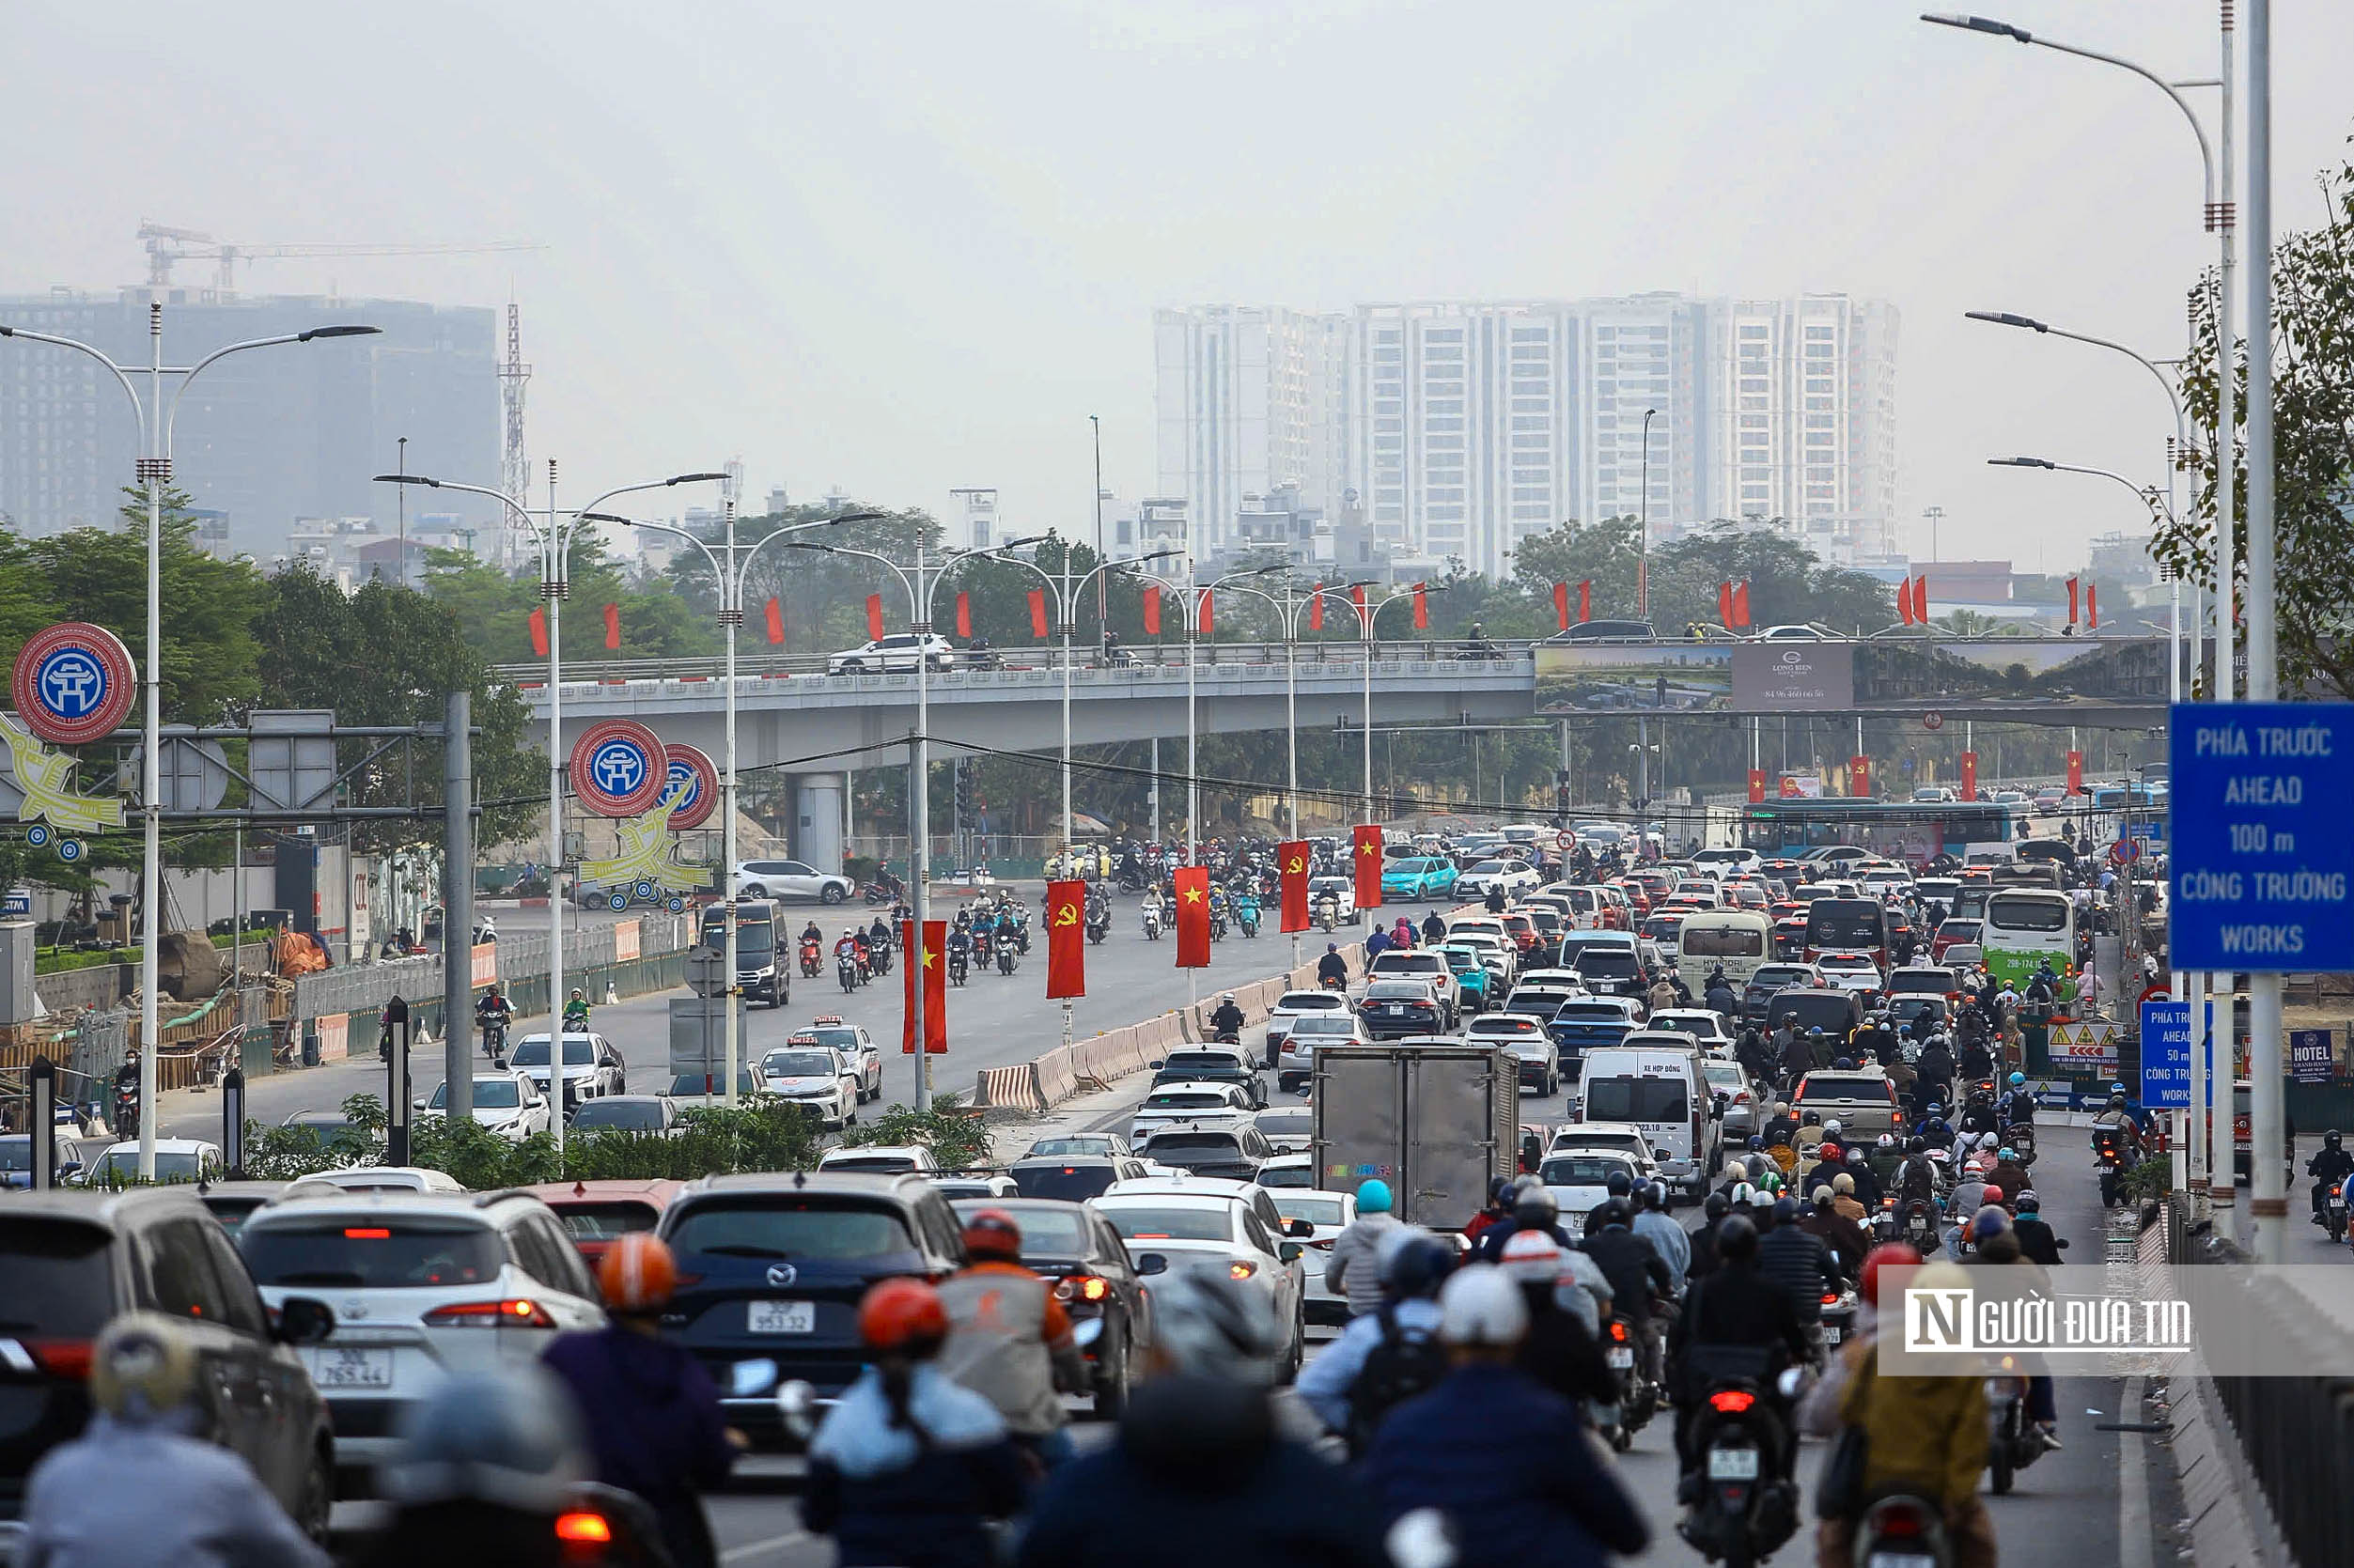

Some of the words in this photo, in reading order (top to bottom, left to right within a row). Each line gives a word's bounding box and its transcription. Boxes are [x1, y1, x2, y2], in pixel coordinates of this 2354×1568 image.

[2195, 719, 2249, 755] PHÍA
[2224, 775, 2302, 804] AHEAD
[2230, 823, 2268, 852] 100
[2274, 831, 2294, 852] m
[2180, 867, 2243, 900] CÔNG
[2220, 924, 2303, 953] WORKS
[2151, 1010, 2173, 1023] PHÍA
[2167, 1049, 2178, 1061] 50
[2180, 1052, 2189, 1061] m
[2294, 1046, 2330, 1062] HOTEL
[1652, 1064, 1663, 1073] HỢP
[2145, 1066, 2171, 1080] CÔNG
